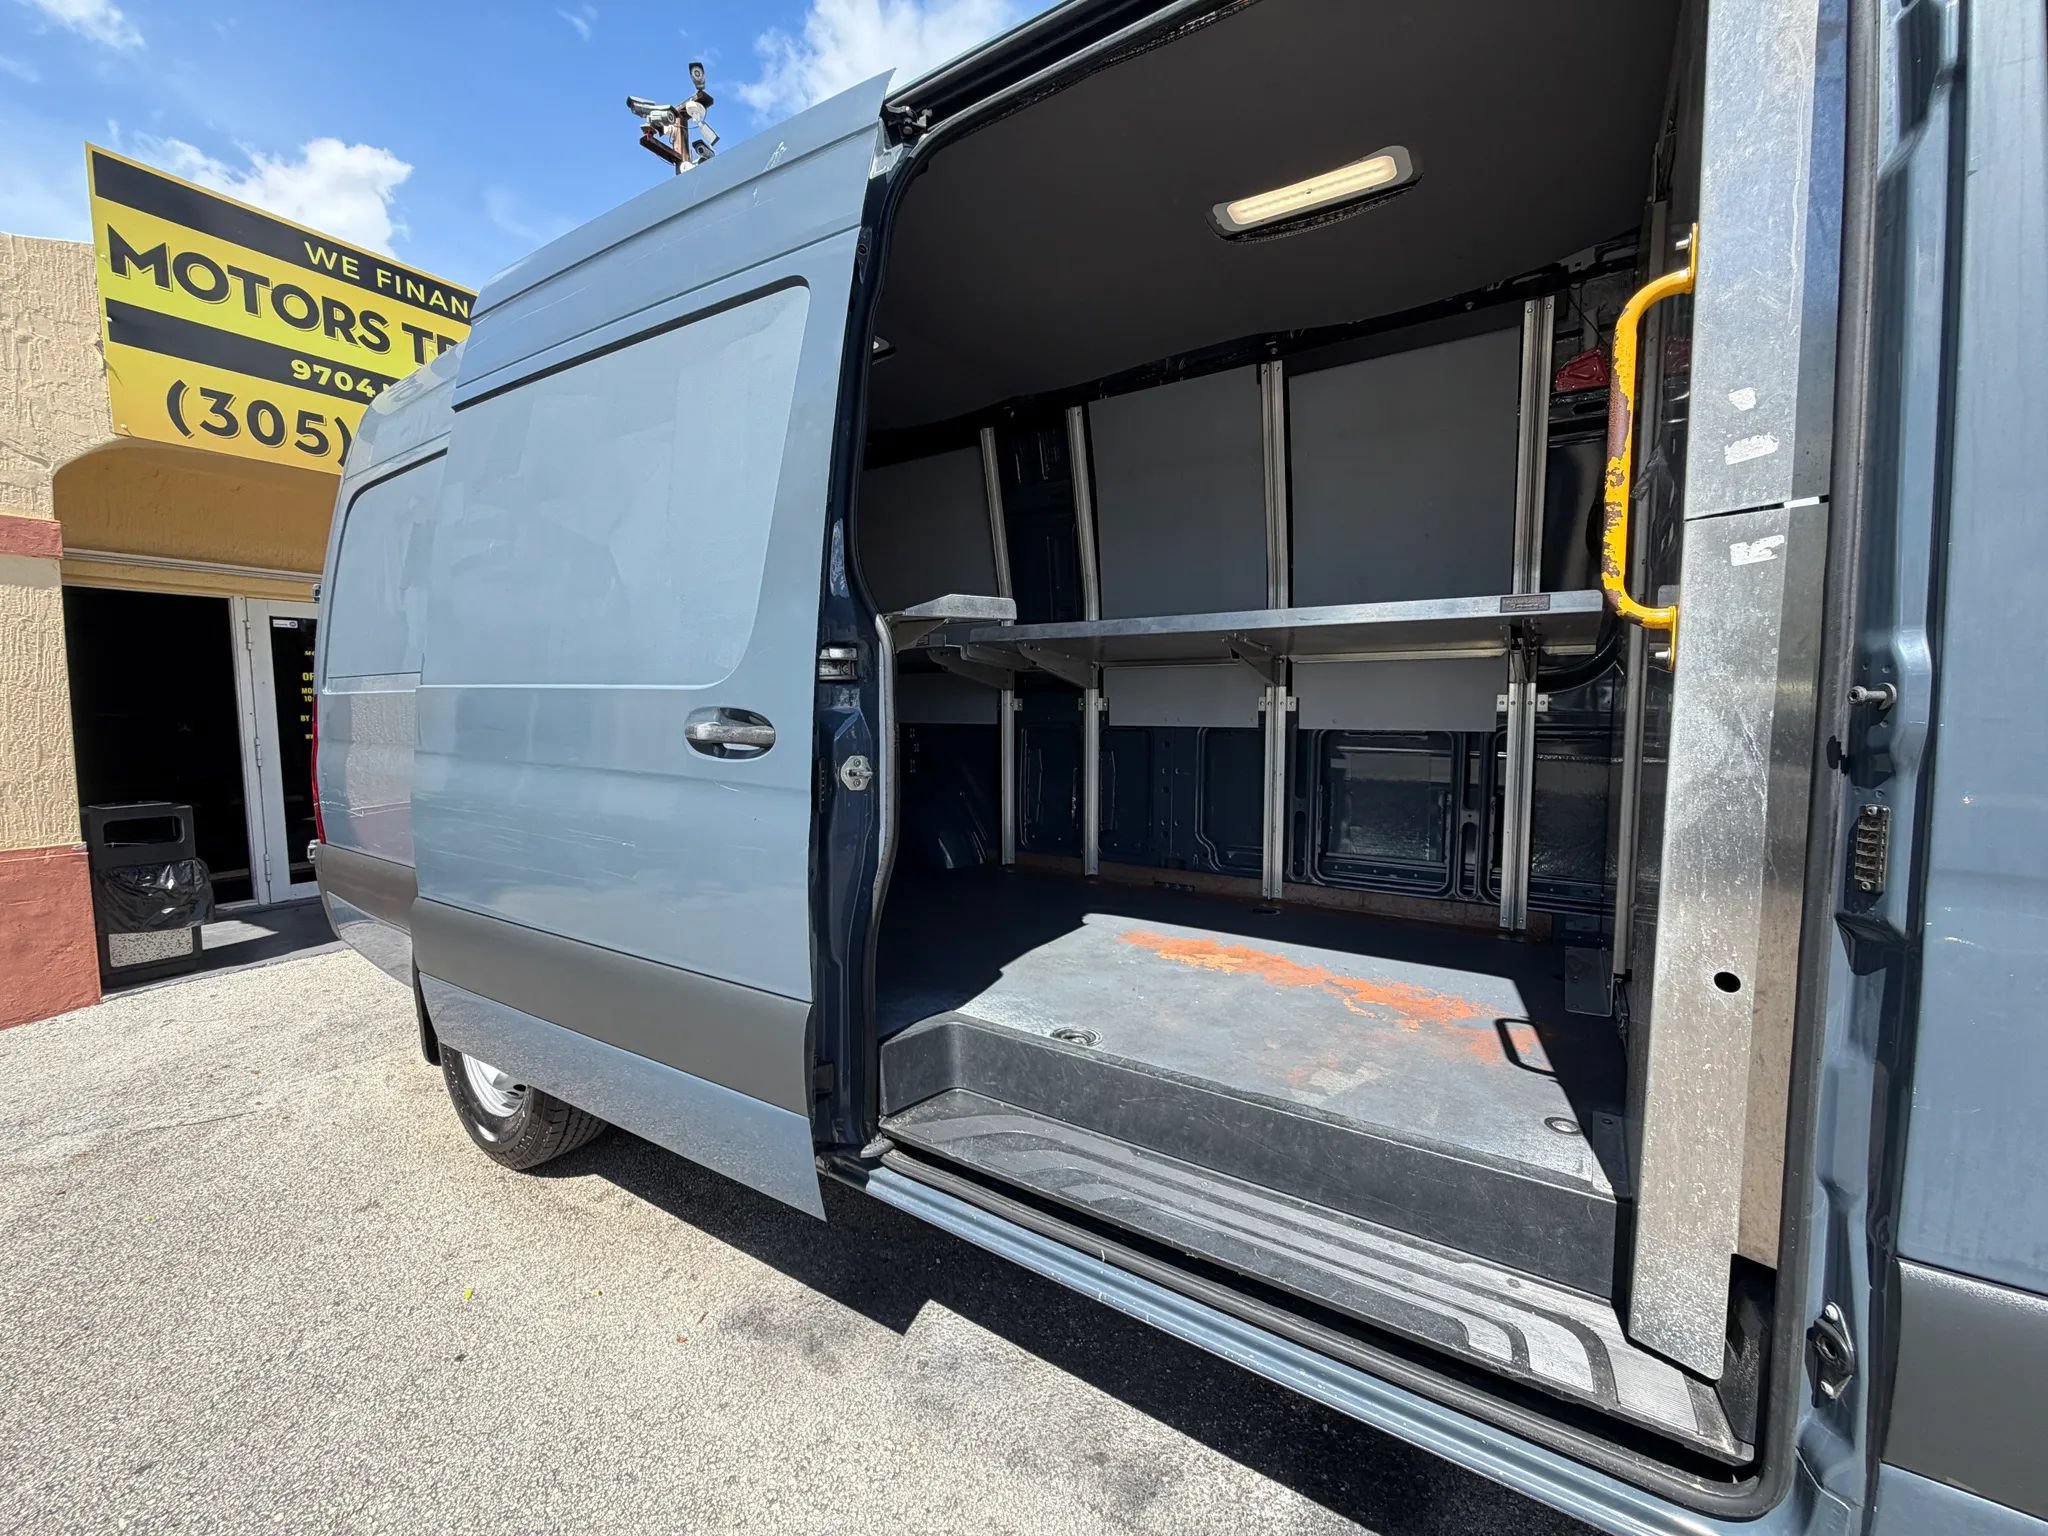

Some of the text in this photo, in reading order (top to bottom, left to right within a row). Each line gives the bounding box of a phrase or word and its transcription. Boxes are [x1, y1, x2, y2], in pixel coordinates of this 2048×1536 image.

[107, 223, 393, 355] MOTORS
[304, 240, 469, 319] WE FINAN
[290, 359, 377, 398] 9704
[167, 379, 354, 468] (305)
